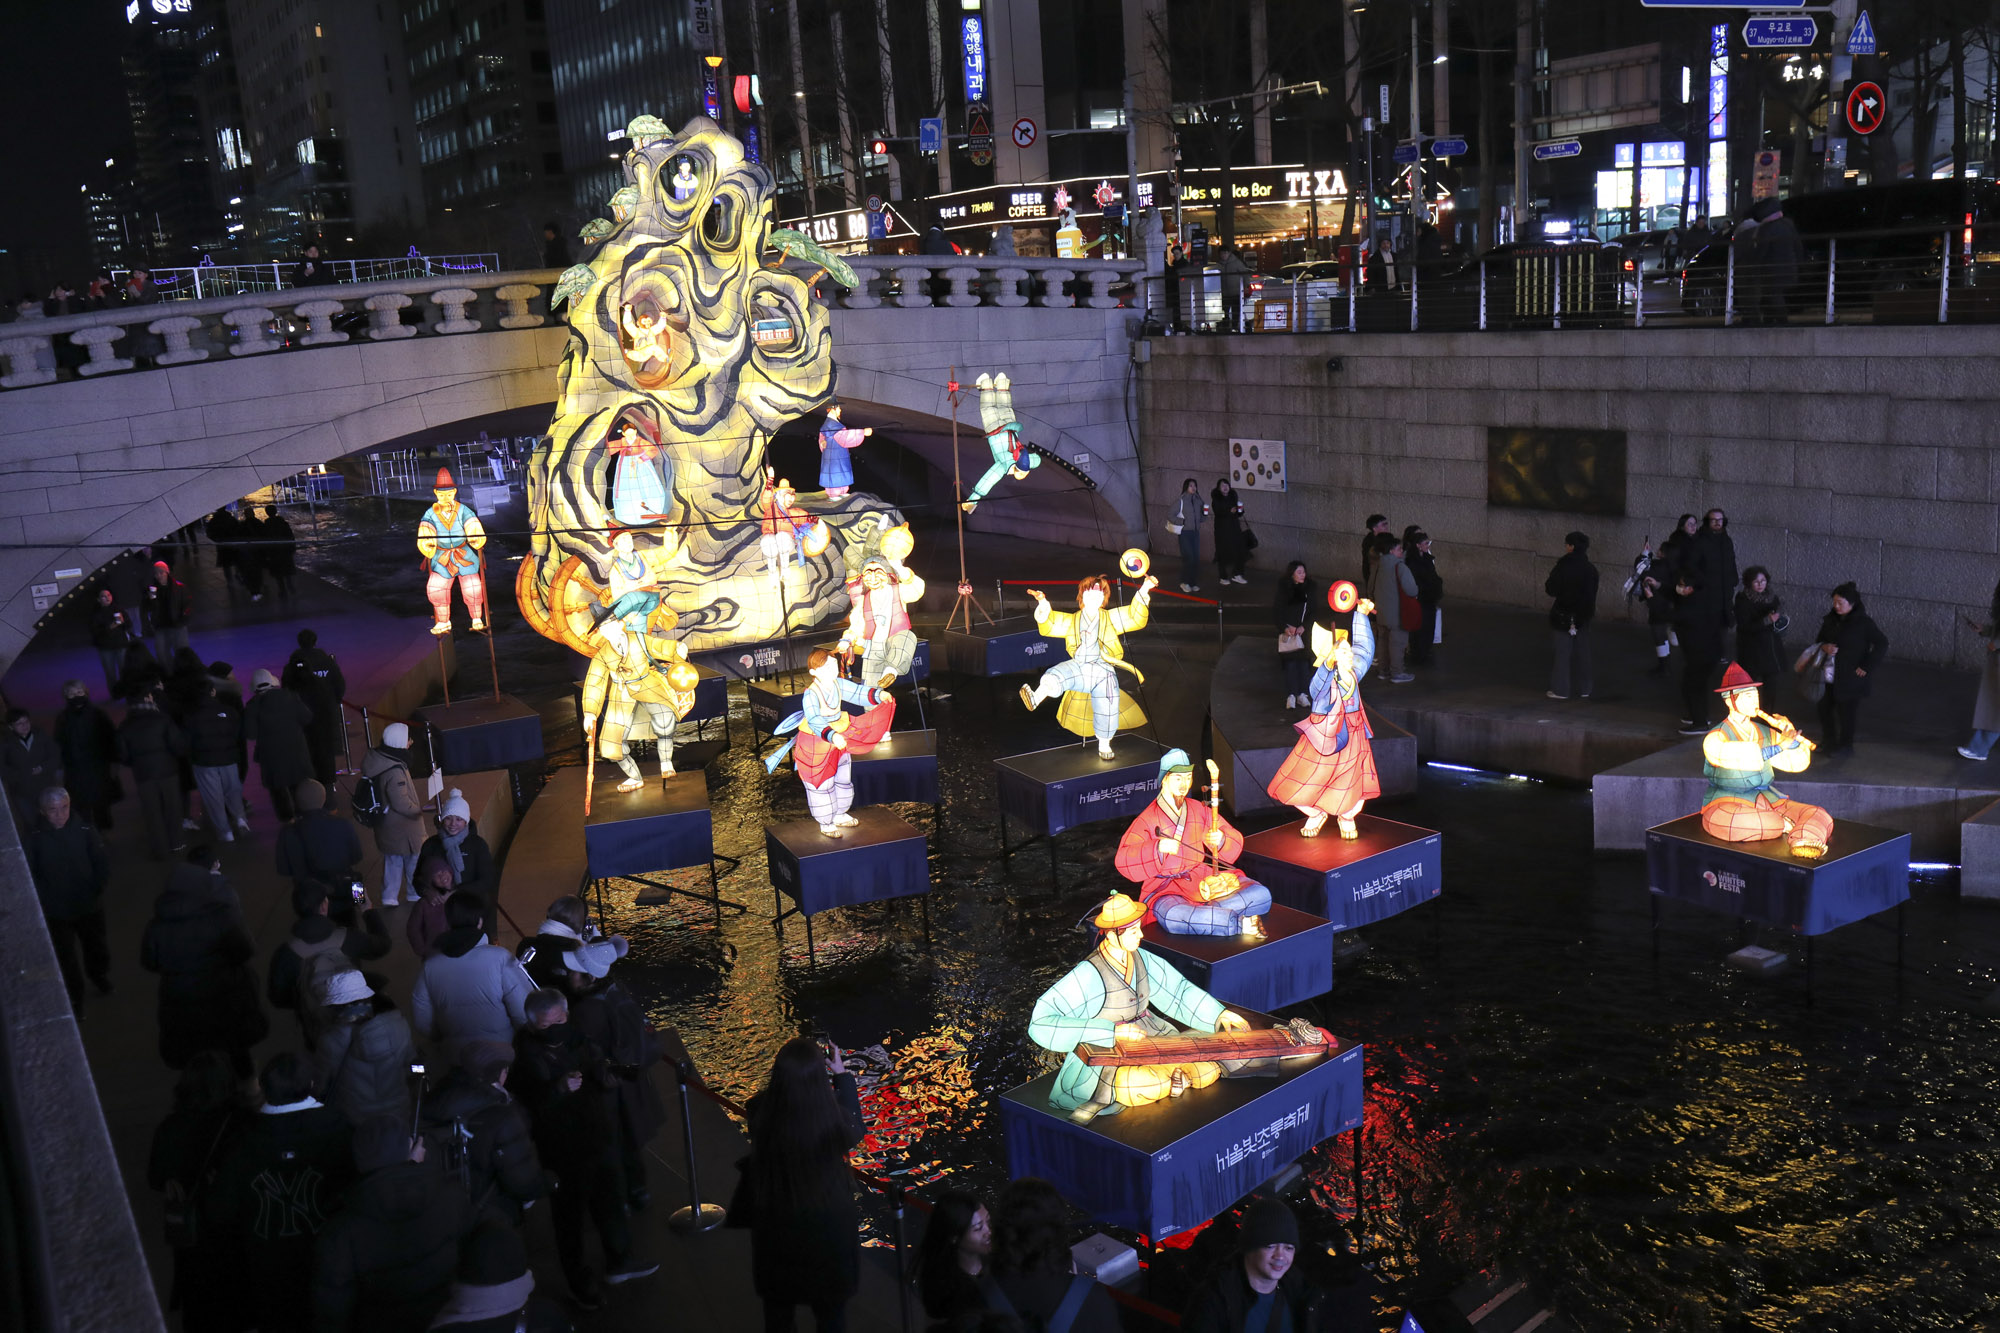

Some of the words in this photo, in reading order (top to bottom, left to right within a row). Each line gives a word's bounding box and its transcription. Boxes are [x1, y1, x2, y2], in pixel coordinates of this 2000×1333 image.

[1749, 28, 1758, 37] 37
[1768, 22, 1792, 33] 무교로
[1803, 27, 1812, 37] 33
[965, 32, 981, 43] 사랑
[967, 55, 983, 93] 내과
[972, 92, 982, 101] 6F
[1137, 183, 1153, 196] EER
[1232, 183, 1249, 198] Ice
[1251, 182, 1273, 197] Bar
[870, 199, 879, 208] 30
[1011, 192, 1042, 206] BEER
[1139, 195, 1154, 207] INE
[1008, 204, 1046, 218] COFFEE
[872, 213, 879, 225] P
[753, 649, 781, 661] WINTER
[755, 657, 776, 668] FESTA
[1079, 778, 1158, 805] 서울빛초롱축제
[1352, 862, 1422, 902] 서울빛초롱축제
[1718, 874, 1746, 889] WINTER
[1718, 881, 1741, 895] FESTA
[1216, 1102, 1310, 1174] 서울빛초롱축제
[250, 1164, 327, 1240] NY
